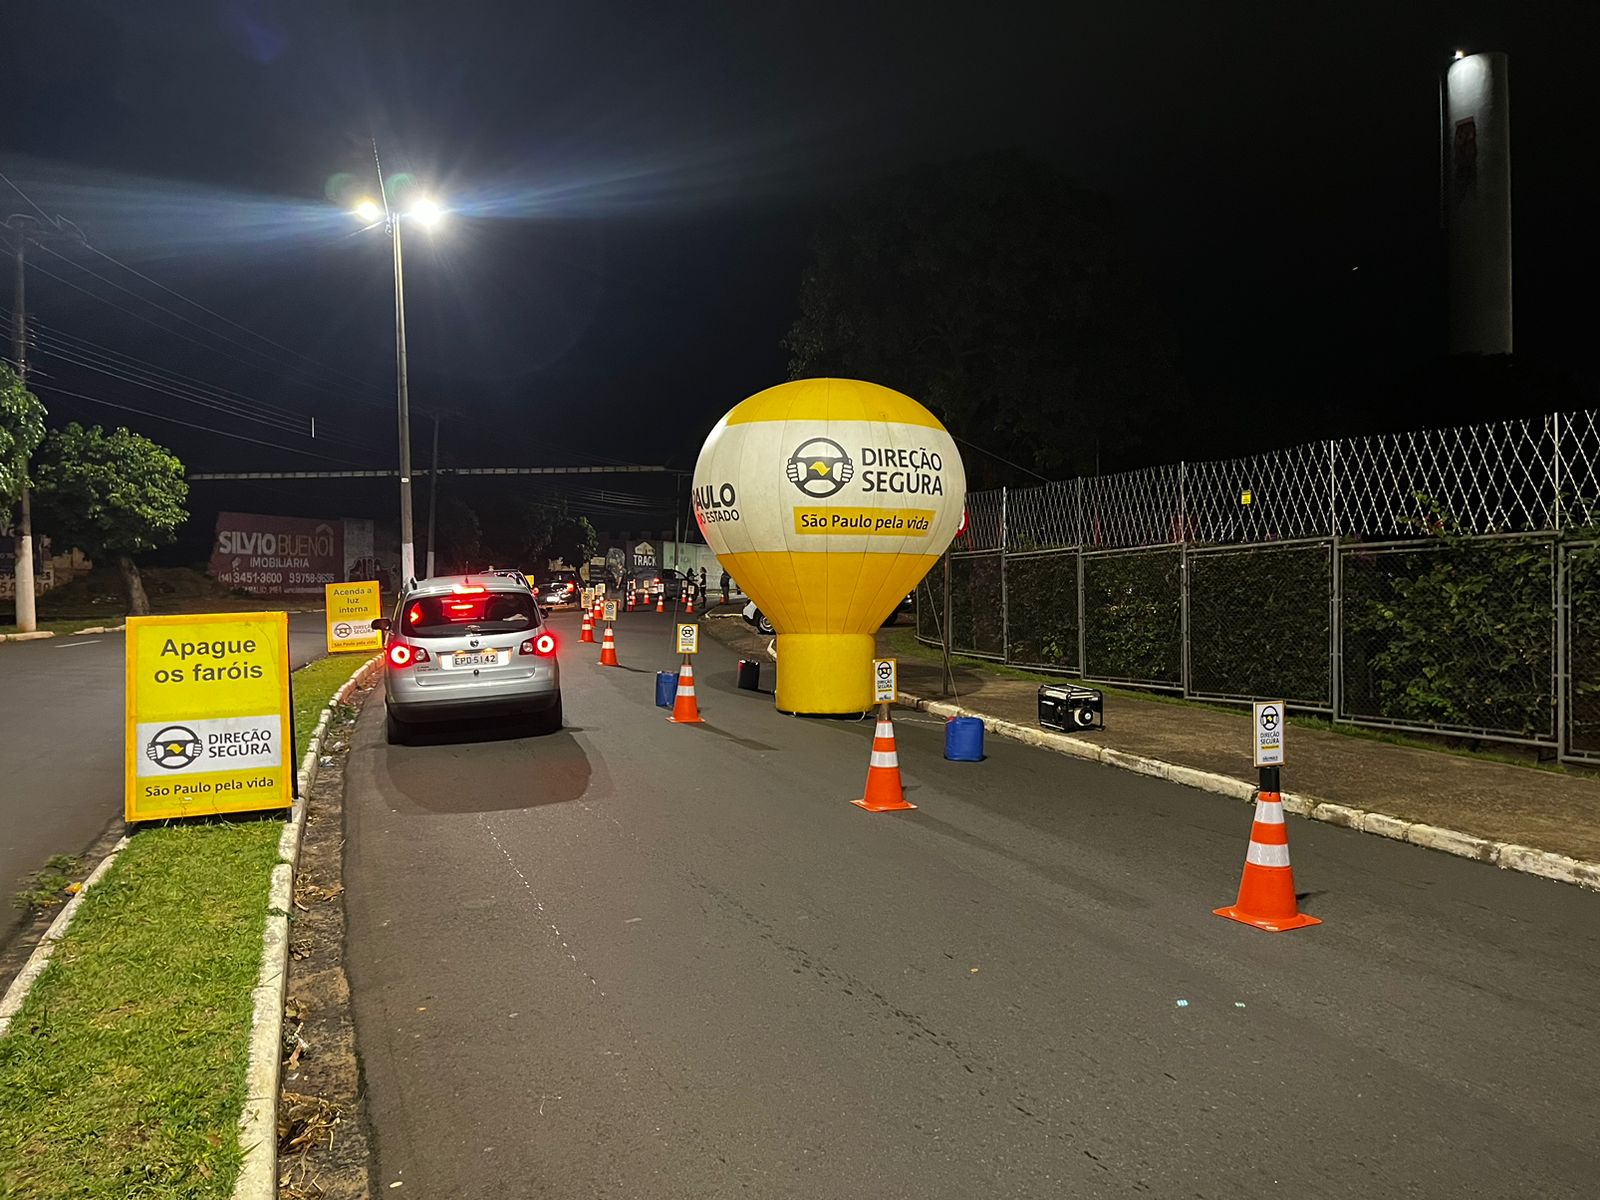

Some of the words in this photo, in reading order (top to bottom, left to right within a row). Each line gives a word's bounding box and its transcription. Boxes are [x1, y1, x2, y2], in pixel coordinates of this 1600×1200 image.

[862, 447, 942, 472] DIREÇÃO
[862, 471, 943, 496] SEGURA
[693, 483, 735, 511] AULO
[705, 509, 740, 523] ESTADO
[801, 514, 827, 528] São
[832, 515, 872, 528] Paulo
[875, 515, 903, 531] pela
[907, 515, 929, 530] vida
[218, 530, 276, 555] SILVIO
[278, 534, 329, 556] BUENO
[333, 588, 365, 596] Acenda
[160, 638, 256, 660] Apague
[154, 669, 184, 683] os
[193, 661, 263, 682] faróis
[208, 729, 272, 745] DIREÇÃO
[208, 743, 271, 758] SEGURA
[145, 786, 170, 797] São
[174, 781, 211, 795] Paulo
[215, 779, 243, 794] pela
[246, 777, 274, 788] vida
